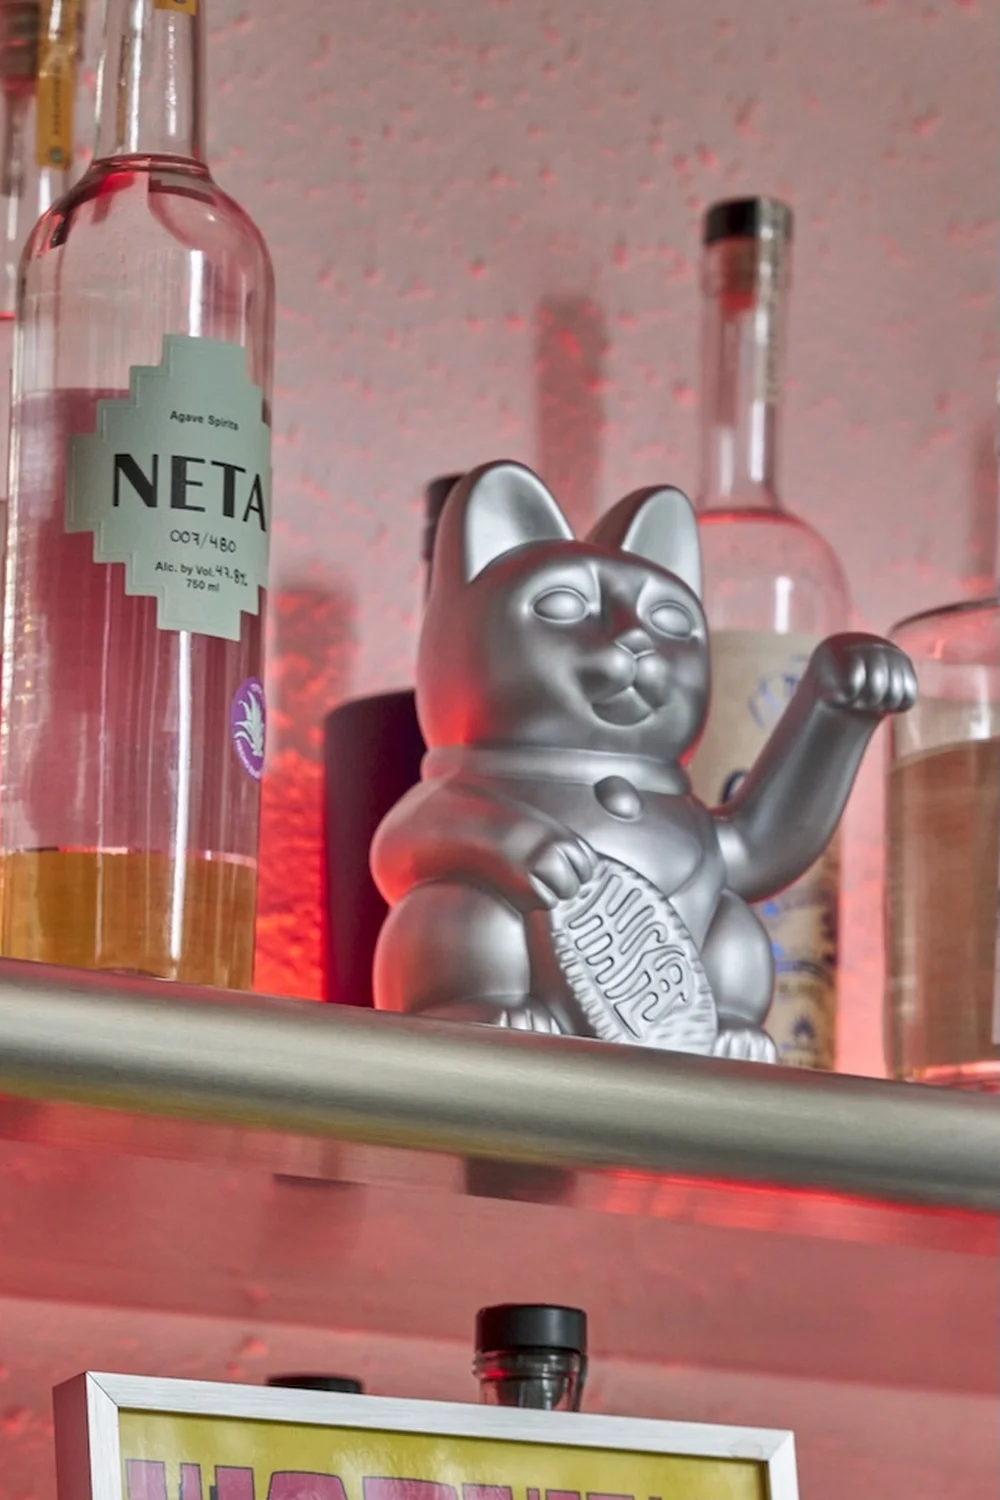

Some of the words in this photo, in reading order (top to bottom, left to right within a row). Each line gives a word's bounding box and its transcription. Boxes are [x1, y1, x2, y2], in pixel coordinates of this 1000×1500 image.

[169, 410, 204, 425] Agave
[207, 415, 239, 431] Spirits
[112, 453, 267, 533] NETA
[155, 561, 178, 573] Alc.
[180, 563, 193, 576] by
[186, 578, 206, 591] 750
[207, 580, 220, 592] ml
